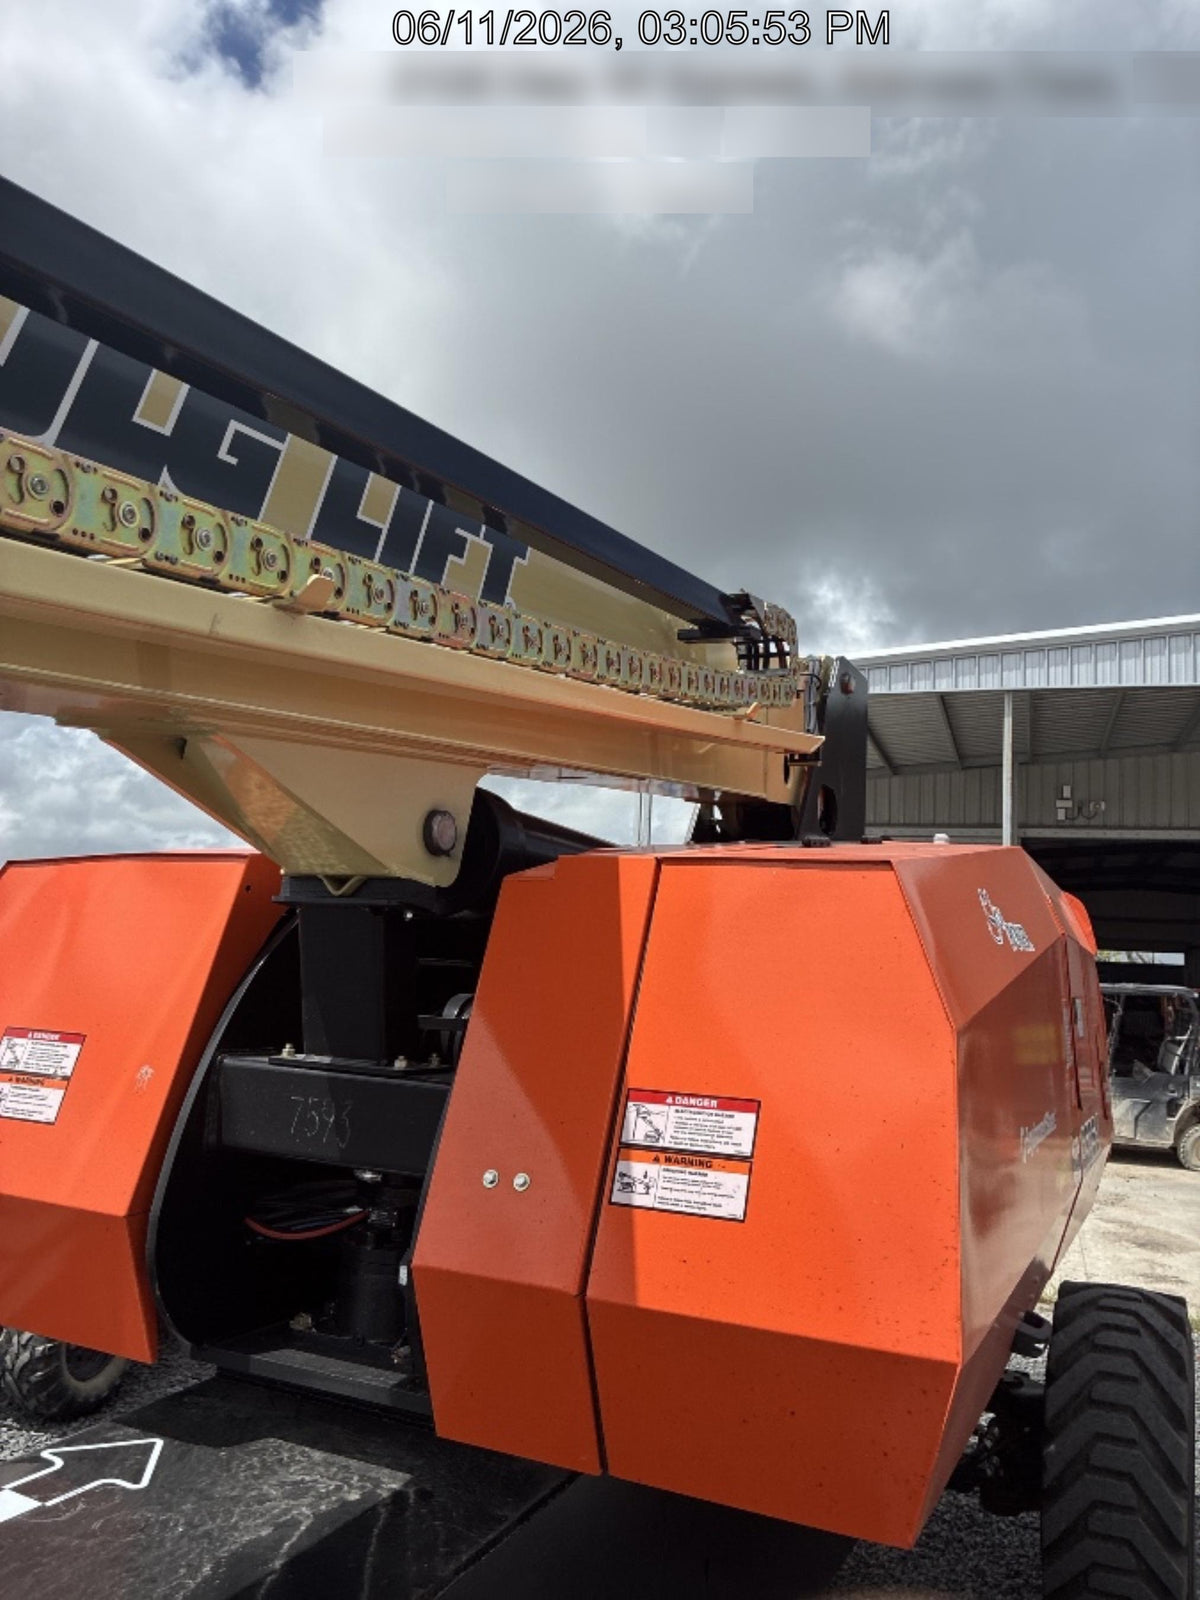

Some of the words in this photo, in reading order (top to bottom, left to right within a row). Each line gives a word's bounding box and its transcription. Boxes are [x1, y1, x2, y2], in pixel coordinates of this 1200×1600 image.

[306, 454, 532, 606] LIFT
[675, 1096, 718, 1109] DANGER
[664, 1155, 713, 1170] WARNING
